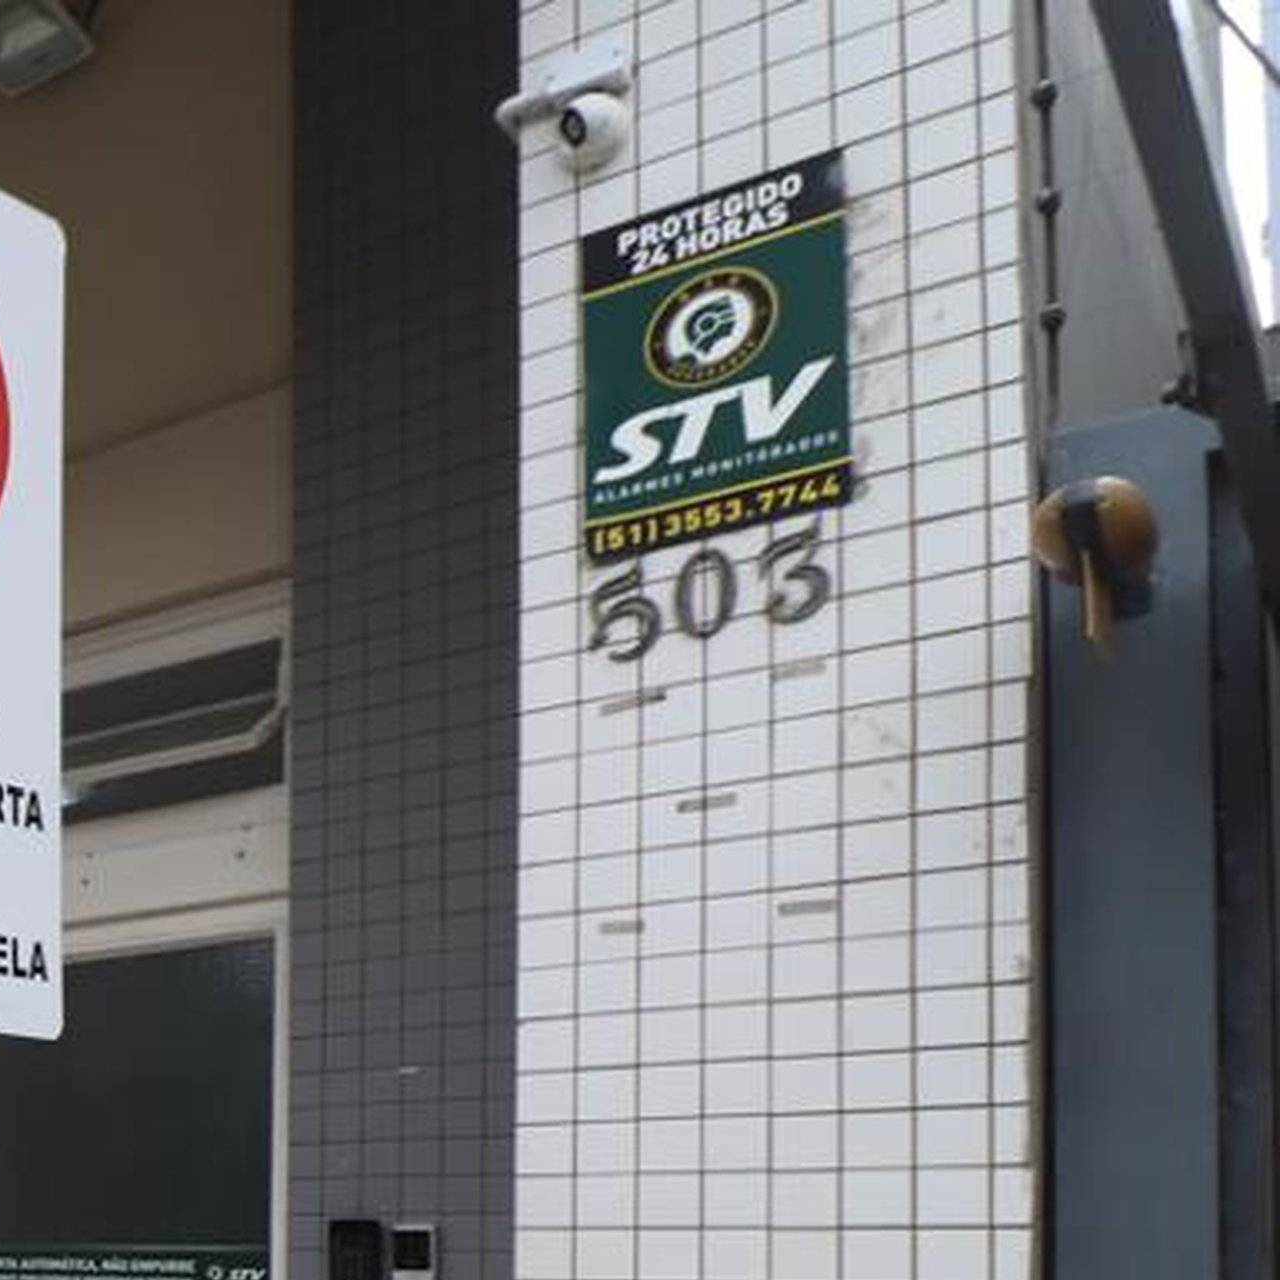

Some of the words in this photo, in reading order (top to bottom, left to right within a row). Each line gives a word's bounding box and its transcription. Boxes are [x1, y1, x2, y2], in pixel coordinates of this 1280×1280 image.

[616, 172, 804, 258] PROTEGIDO
[629, 245, 671, 275] 24
[676, 202, 789, 260] HORAS
[592, 354, 836, 484] STV
[594, 472, 684, 504] ALARMES
[691, 431, 840, 480] MONITORADOS
[587, 518, 832, 664] 503
